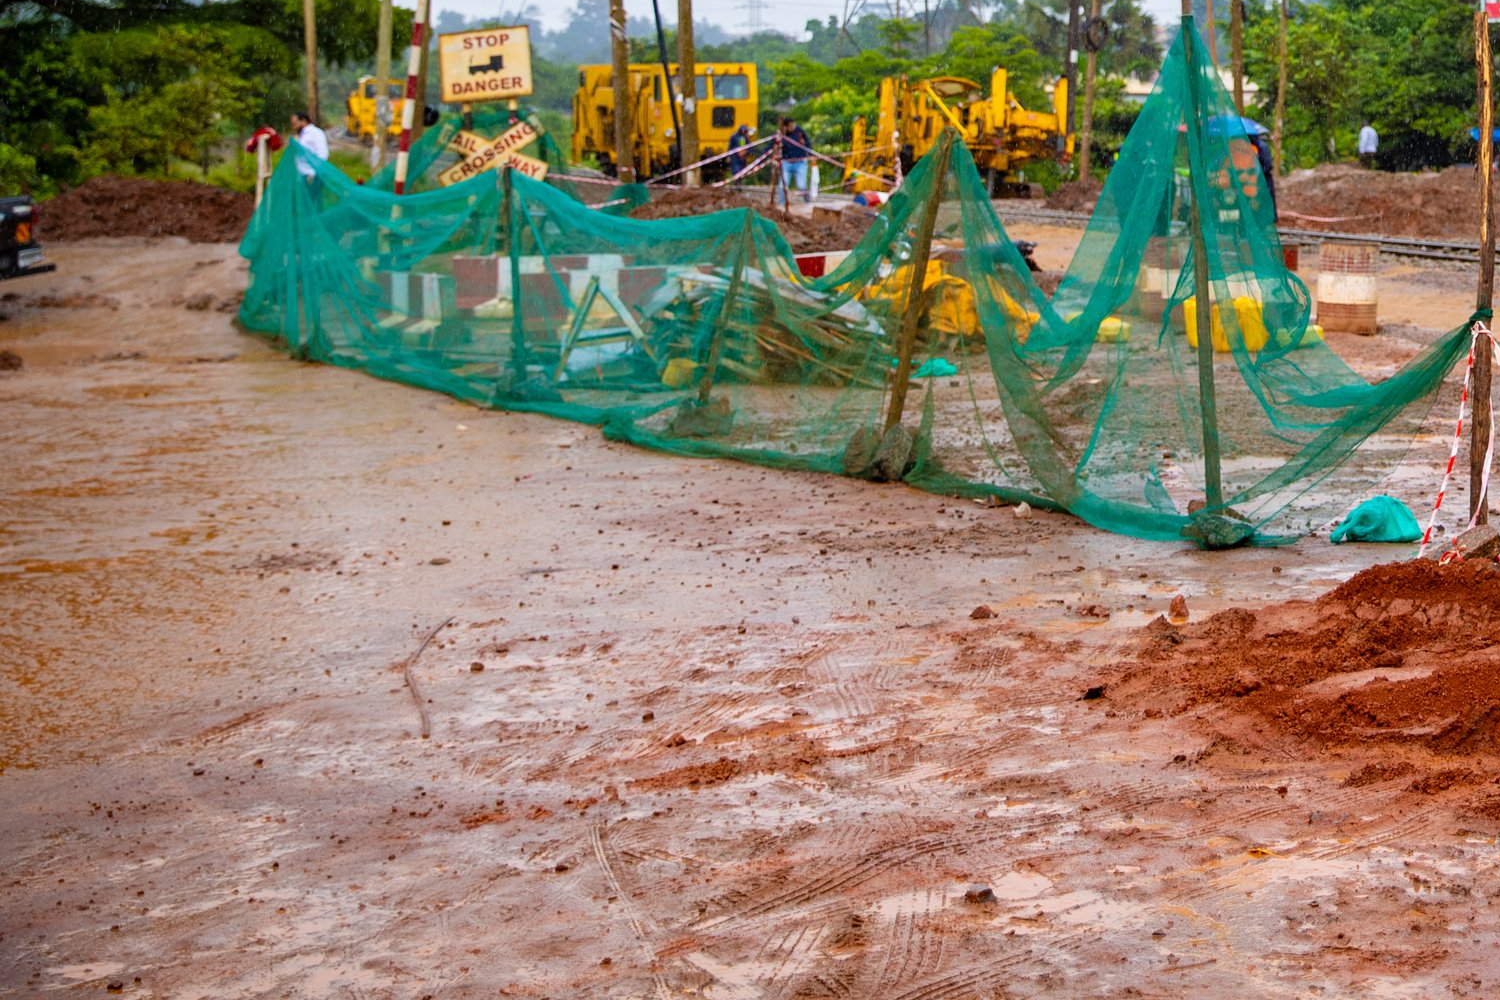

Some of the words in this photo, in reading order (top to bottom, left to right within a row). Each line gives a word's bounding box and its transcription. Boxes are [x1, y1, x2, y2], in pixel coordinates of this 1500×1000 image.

[462, 33, 510, 50] STOP
[452, 76, 524, 96] DANGER
[450, 123, 534, 183] CROSSING
[508, 155, 541, 177] WAY
